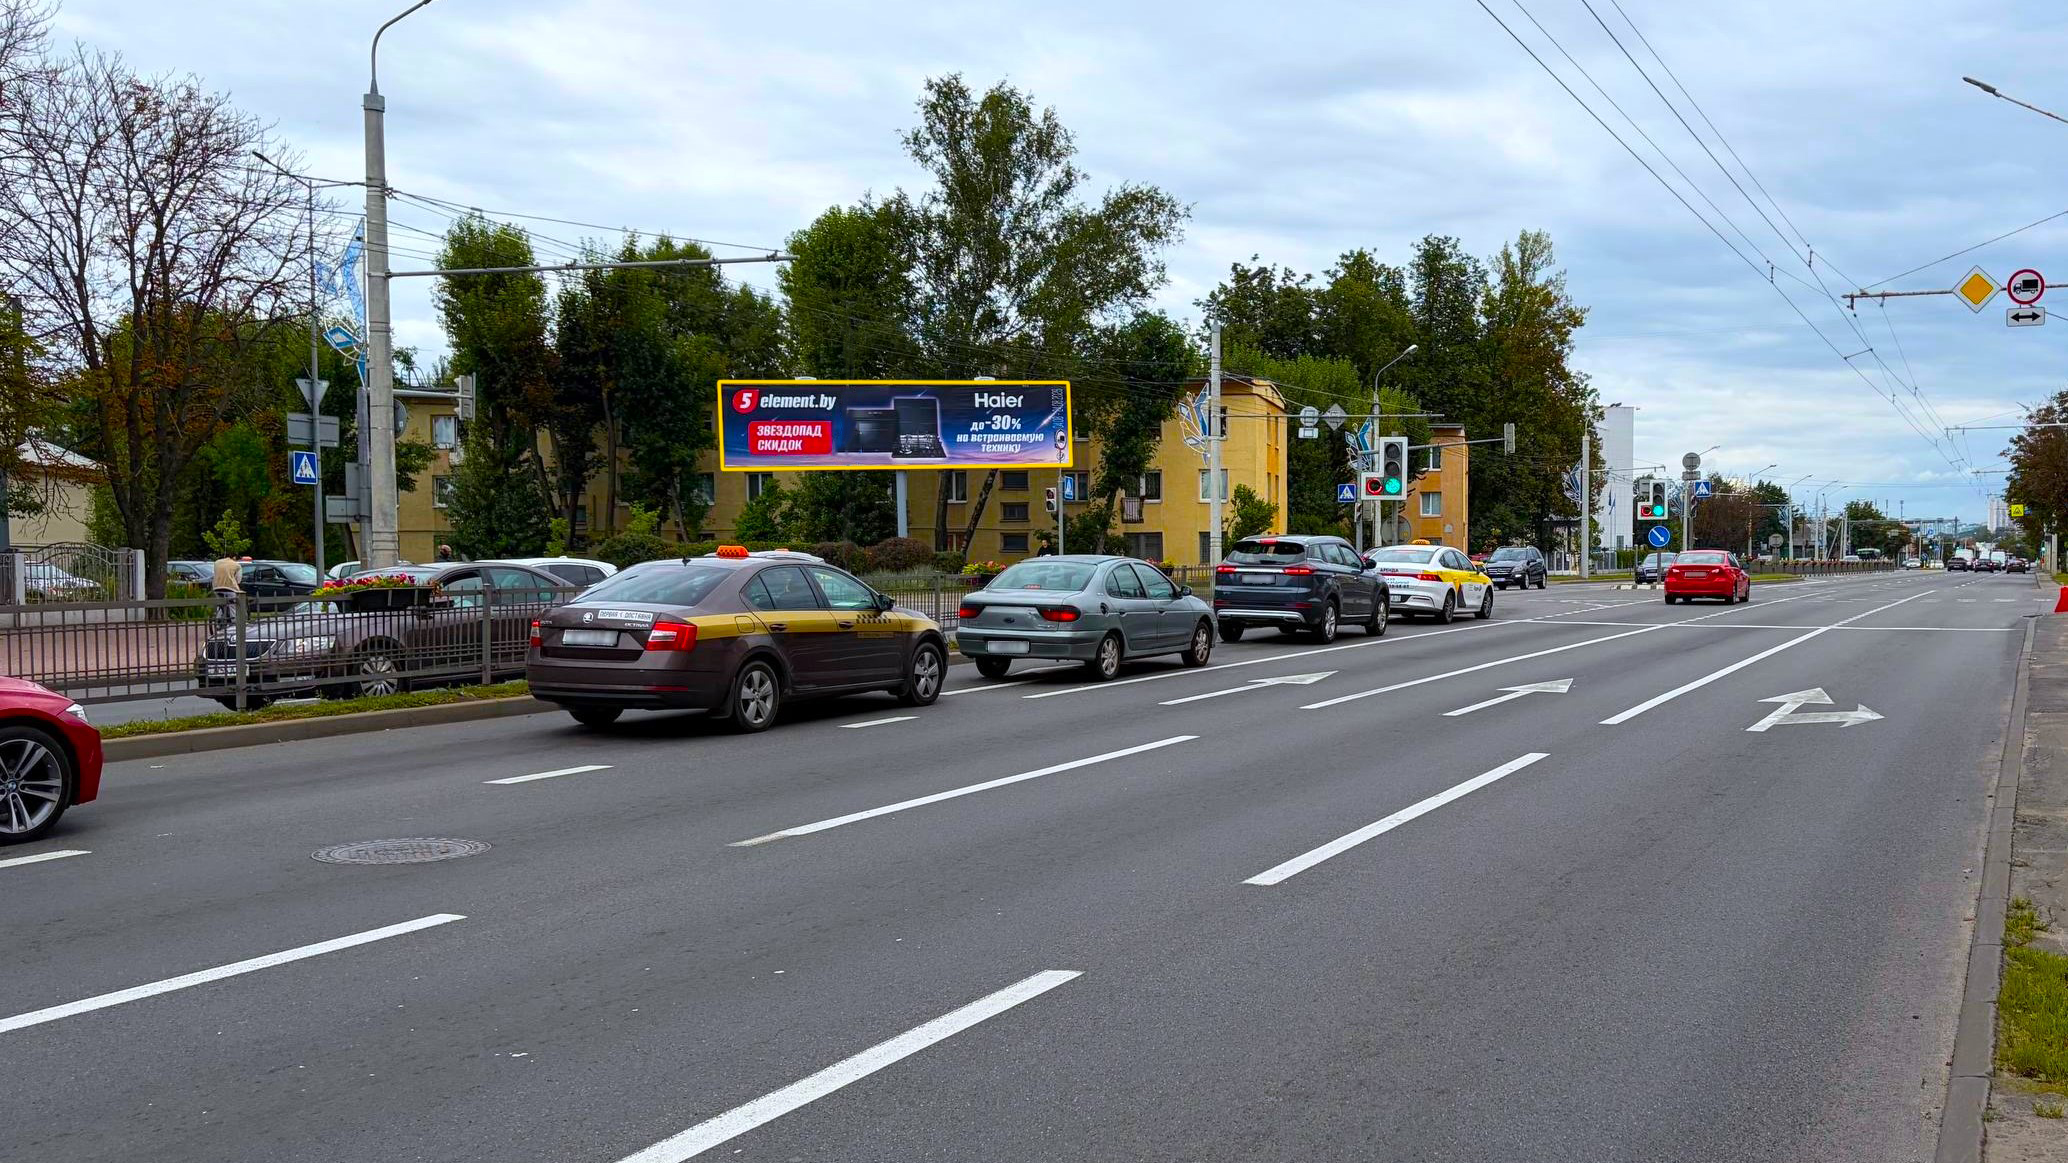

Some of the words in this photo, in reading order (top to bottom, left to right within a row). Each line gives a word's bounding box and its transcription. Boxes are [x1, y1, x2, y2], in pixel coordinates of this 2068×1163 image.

[740, 392, 753, 409] 5
[760, 394, 836, 410] element.by
[974, 392, 1024, 408] Haier
[970, 421, 985, 432] до
[985, 414, 1021, 430] -30%
[756, 425, 822, 437] ЗВЕЗДОПАД
[956, 433, 969, 443] на
[971, 432, 1044, 443] встраиваемую
[757, 440, 803, 452] СКИДОК
[981, 443, 1021, 453] технику
